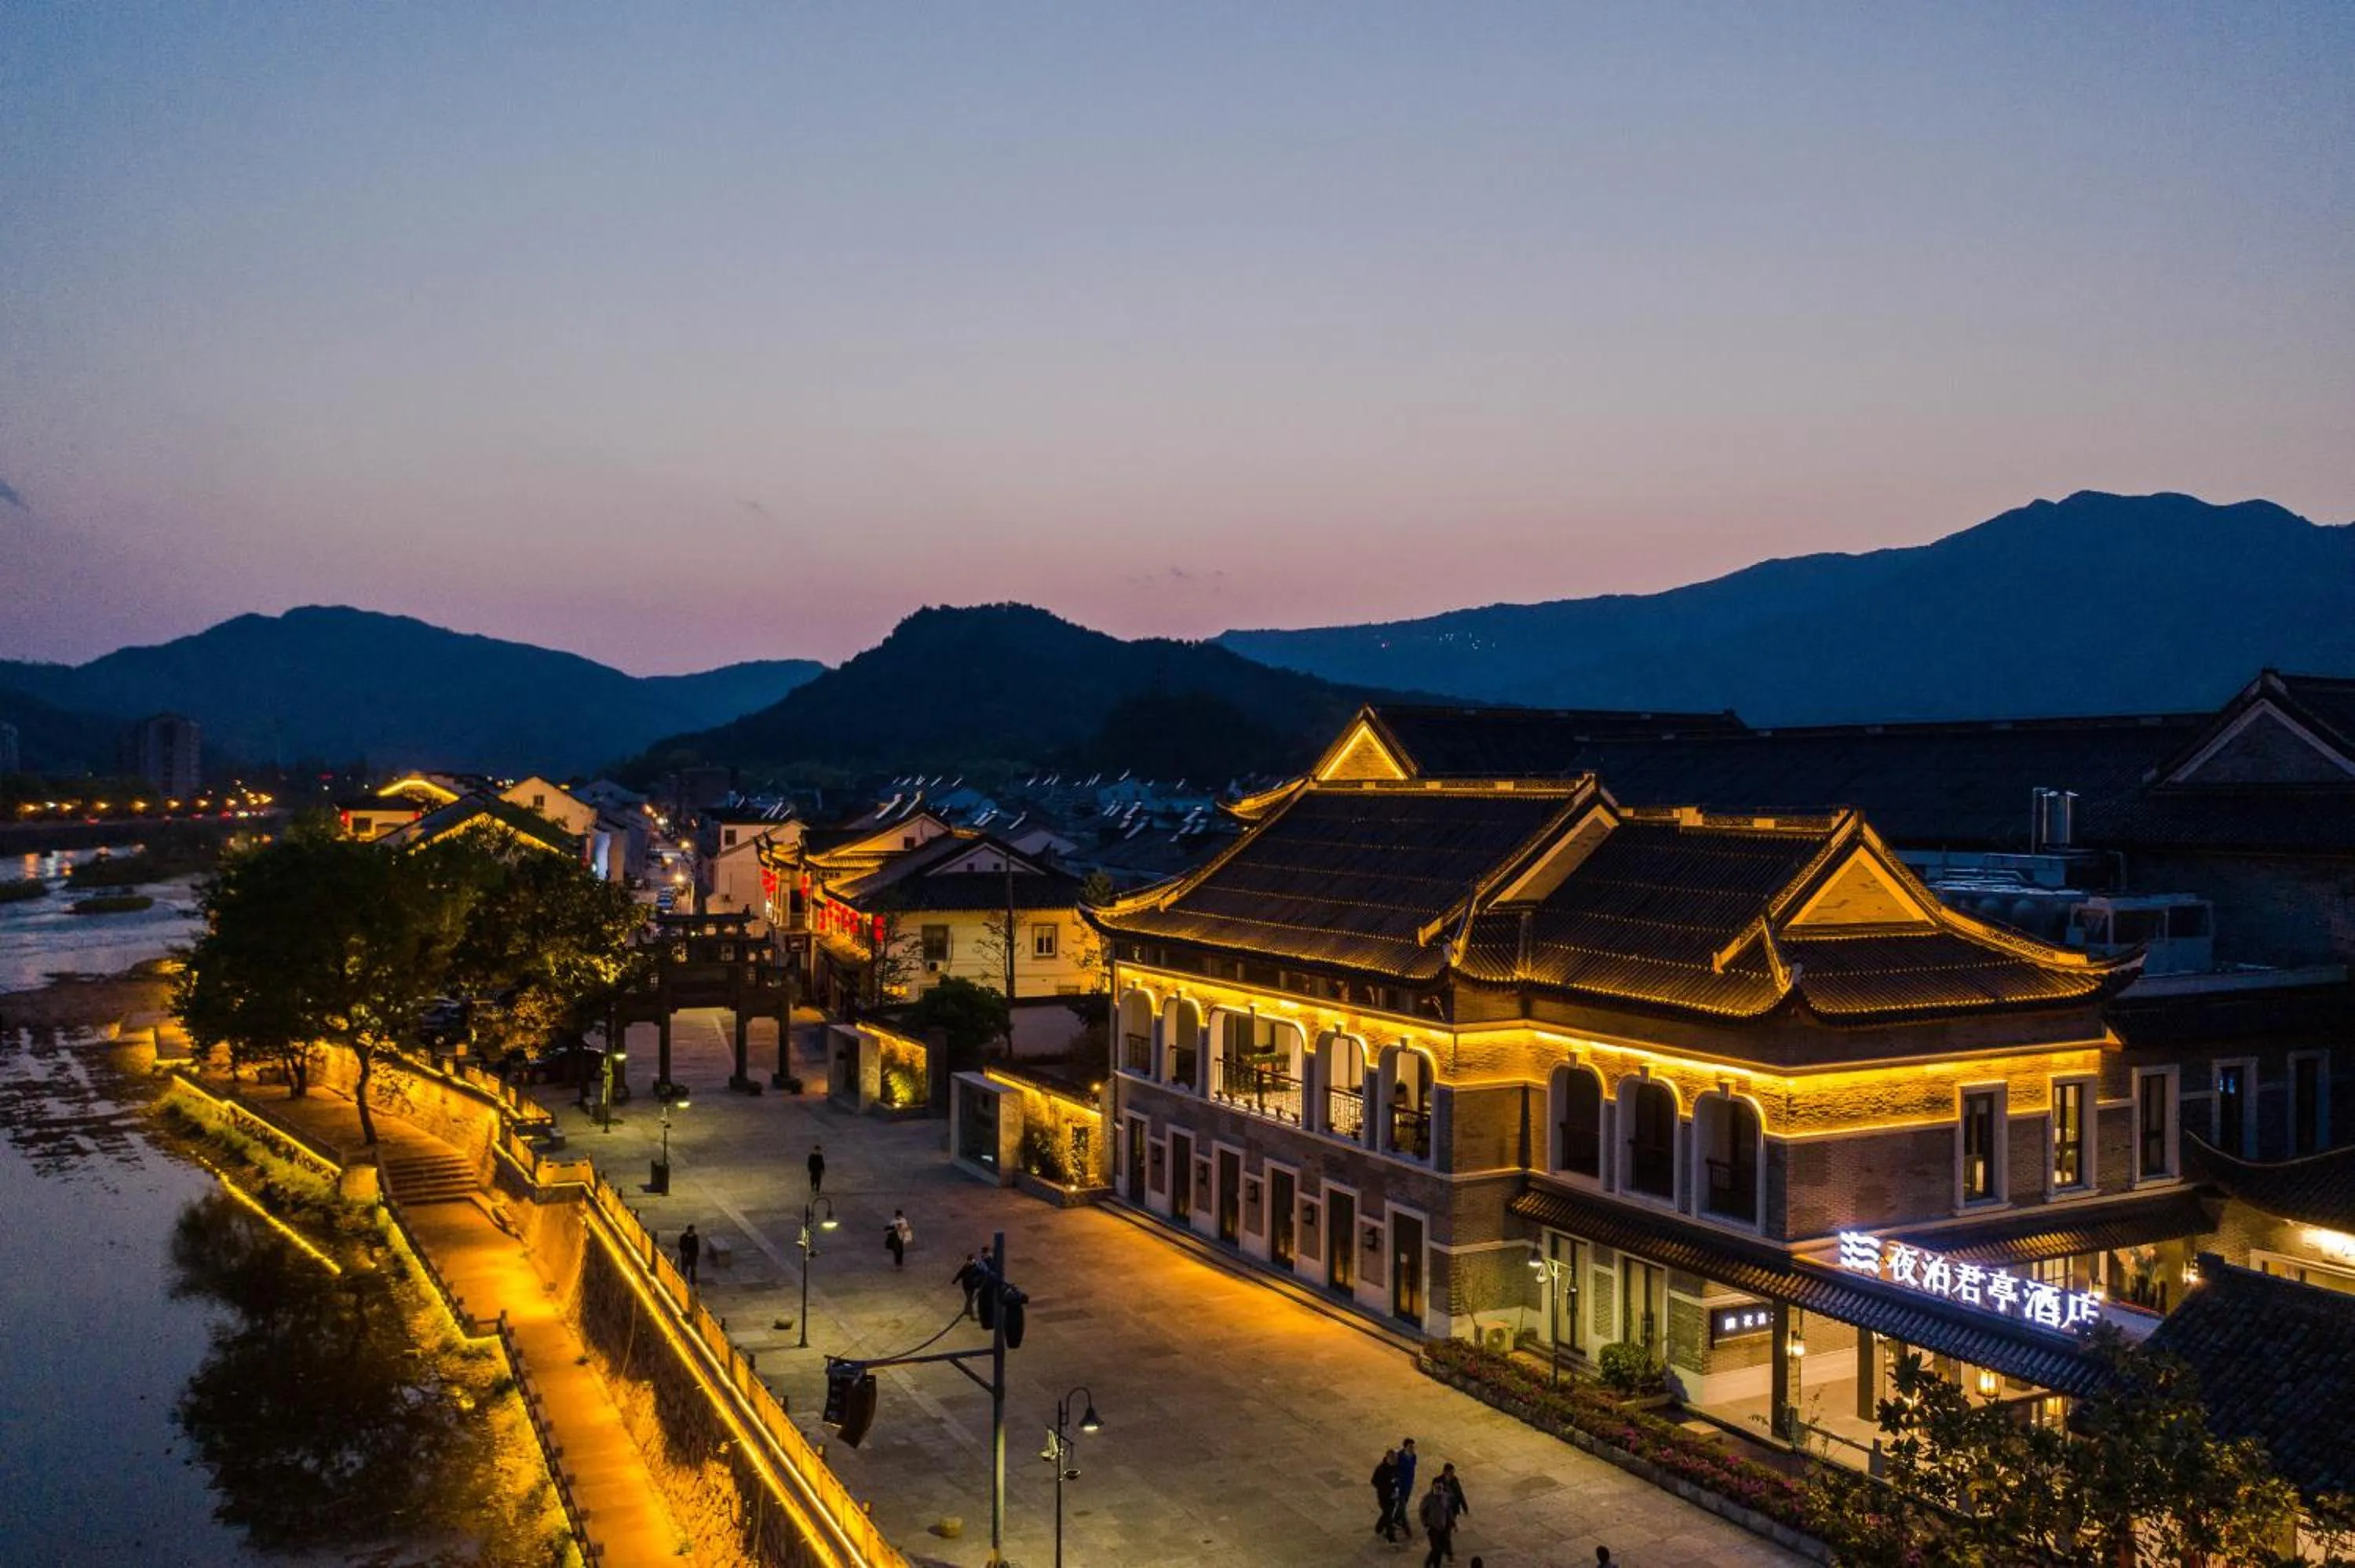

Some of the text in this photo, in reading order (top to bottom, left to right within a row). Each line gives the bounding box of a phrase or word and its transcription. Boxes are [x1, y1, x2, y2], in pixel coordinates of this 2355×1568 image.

[1886, 1242, 2101, 1330] 夜泊君亭酒店
